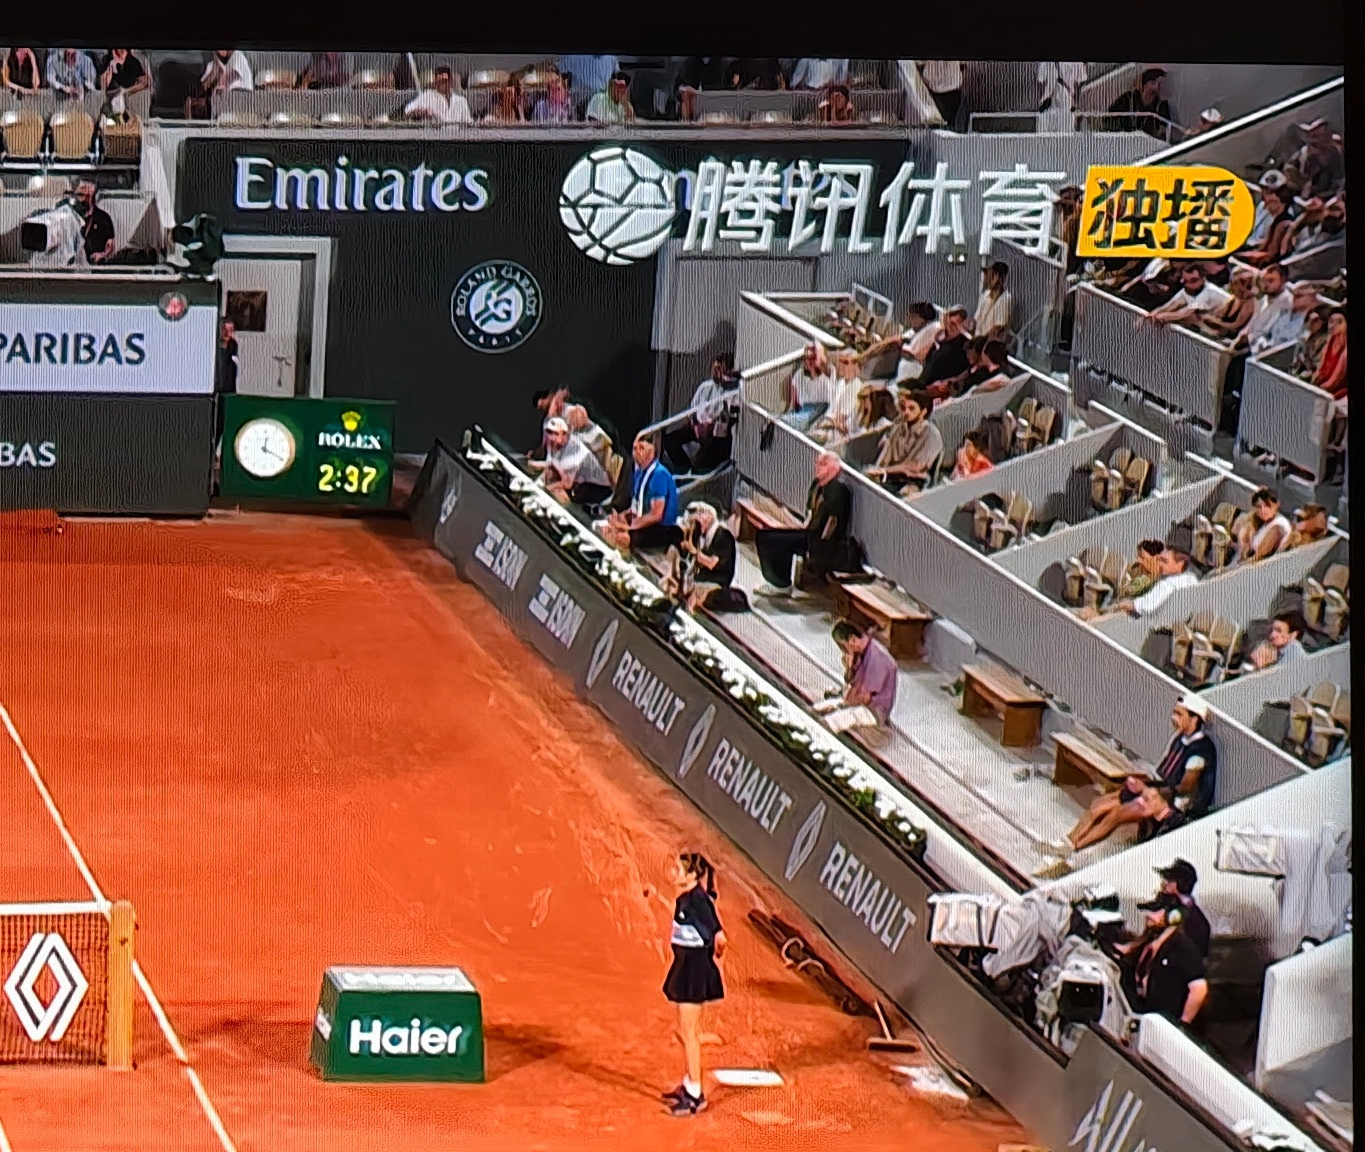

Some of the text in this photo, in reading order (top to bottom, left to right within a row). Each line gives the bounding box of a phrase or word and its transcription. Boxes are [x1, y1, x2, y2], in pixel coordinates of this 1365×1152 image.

[234, 156, 491, 213] Emirates
[682, 158, 1069, 256] 腾讯体育
[1089, 177, 1235, 250] 独播
[319, 431, 382, 450] ROLEX
[318, 464, 377, 494] 2:37
[611, 649, 686, 737] RENAULT
[707, 737, 793, 834] RENAULT
[820, 840, 917, 953] RENAULT
[349, 1017, 463, 1055] Haier
